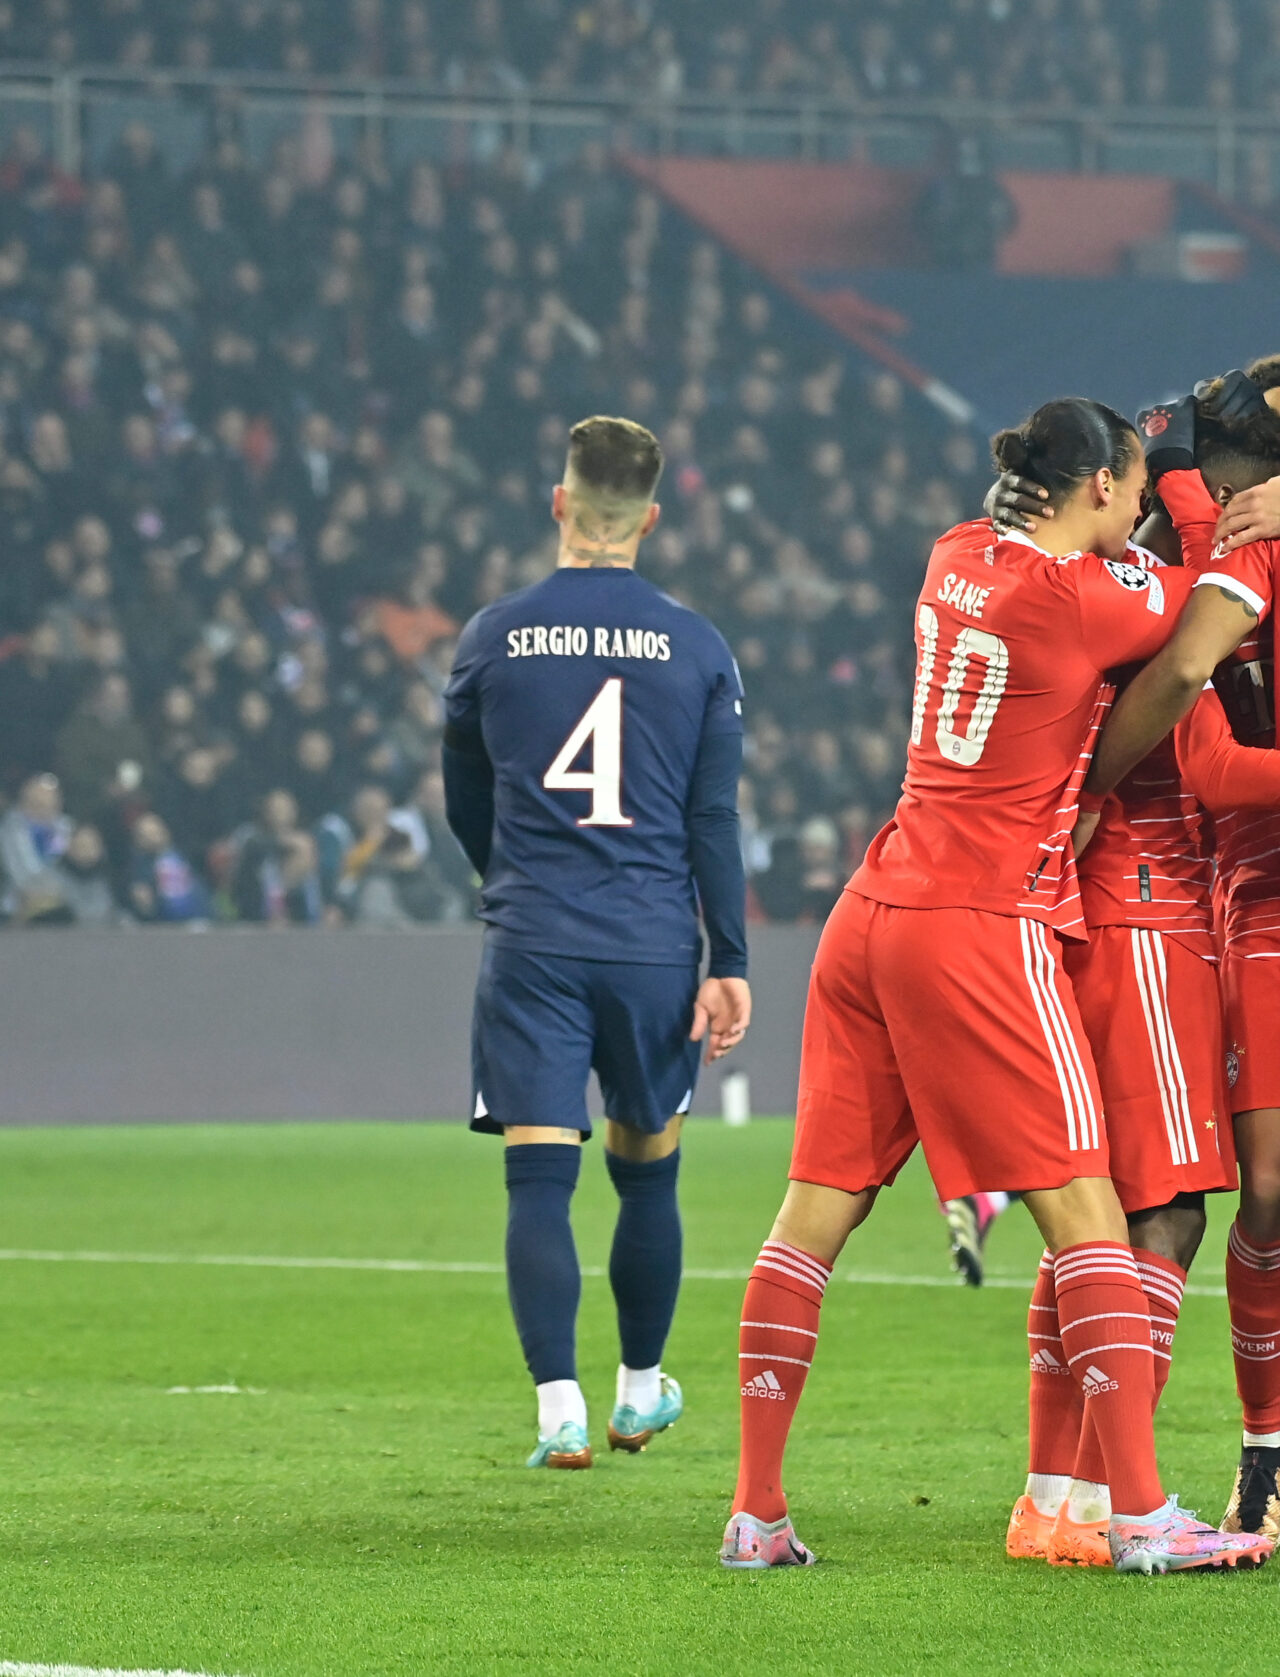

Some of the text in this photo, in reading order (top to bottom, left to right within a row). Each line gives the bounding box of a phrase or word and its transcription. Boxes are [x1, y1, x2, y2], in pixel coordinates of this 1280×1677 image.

[937, 573, 995, 618] SANÉ
[507, 626, 671, 661] SERGIO RAMOS
[912, 604, 1009, 766] 10
[543, 677, 634, 827] 4
[740, 1385, 787, 1401] adidas
